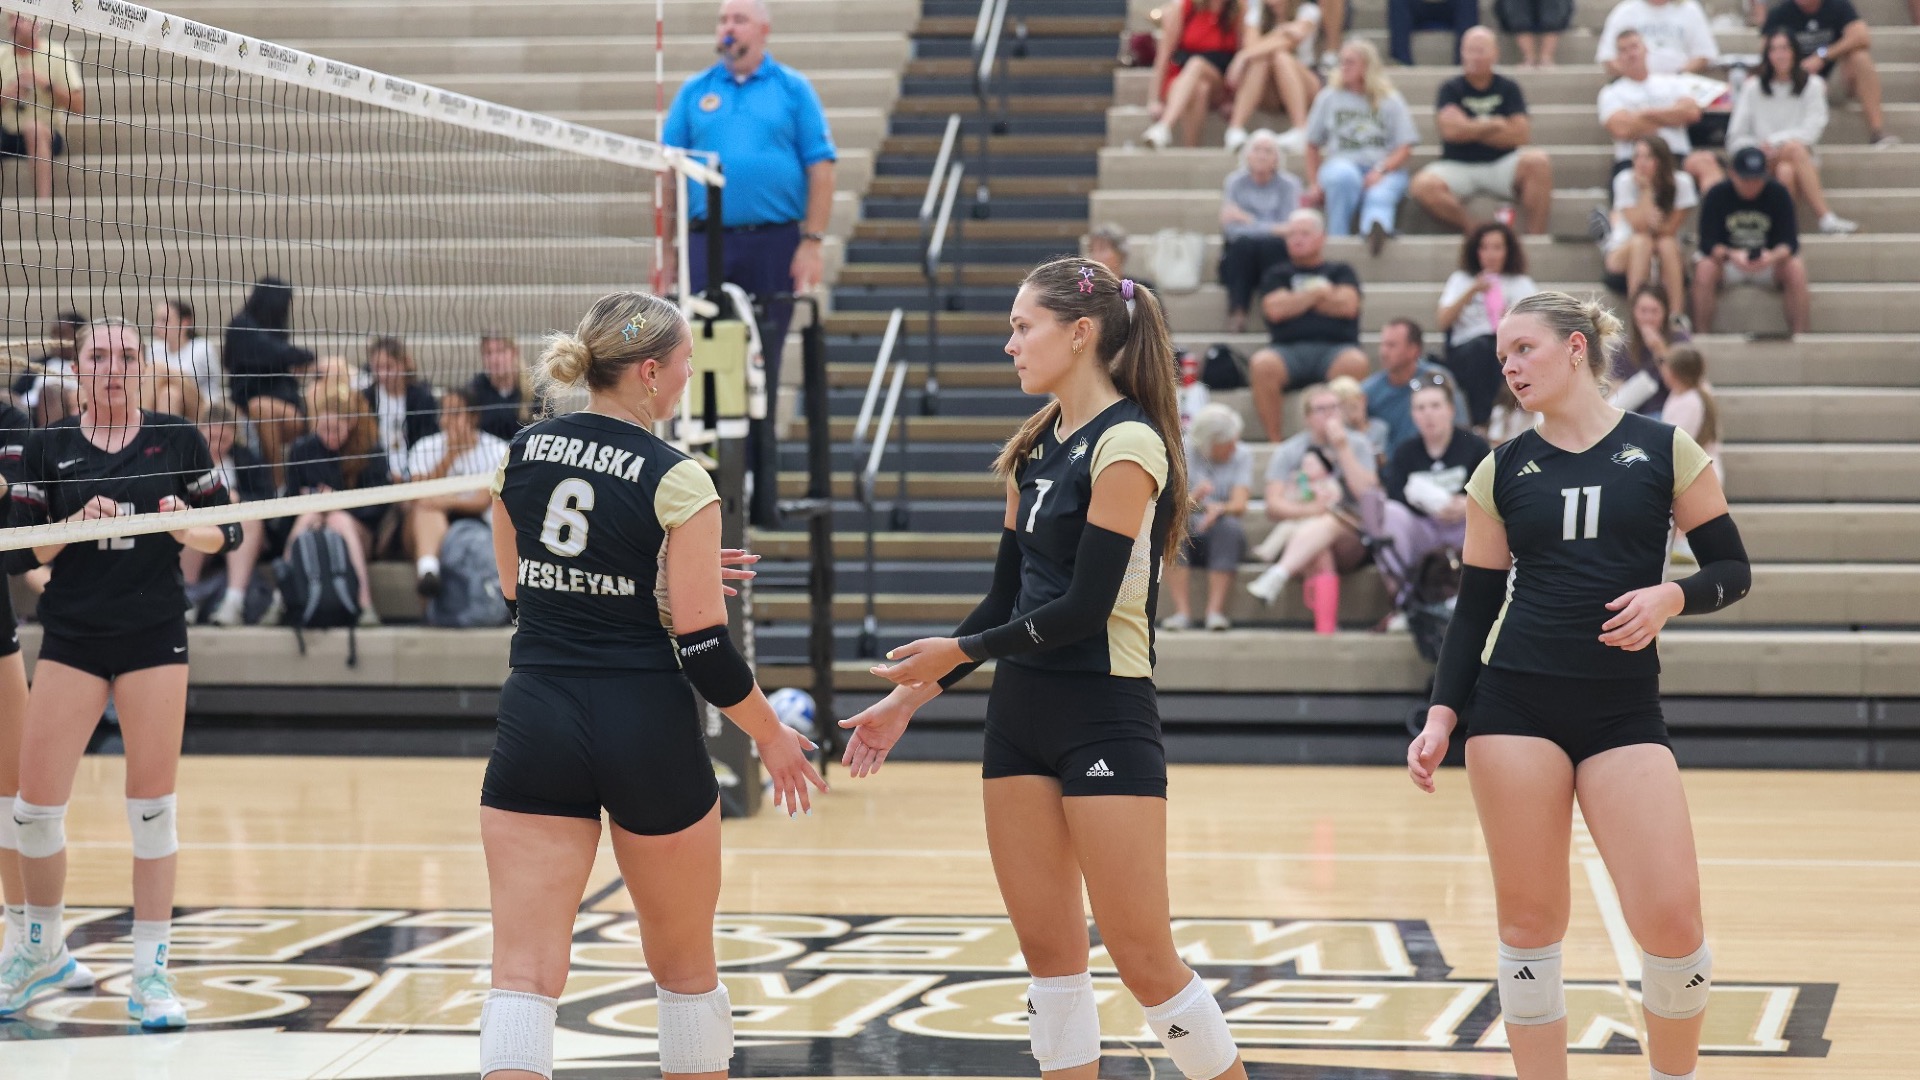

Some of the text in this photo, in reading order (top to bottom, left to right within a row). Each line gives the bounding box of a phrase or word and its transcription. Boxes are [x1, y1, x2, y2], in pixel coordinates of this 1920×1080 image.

[522, 434, 646, 483] NEBRASKA
[539, 478, 595, 558] 6
[1025, 478, 1055, 534] 7
[1561, 485, 1602, 541] 11
[517, 556, 636, 597] WESLEYAN
[1085, 769, 1115, 777] adidas
[1167, 1029, 1190, 1040] adidas
